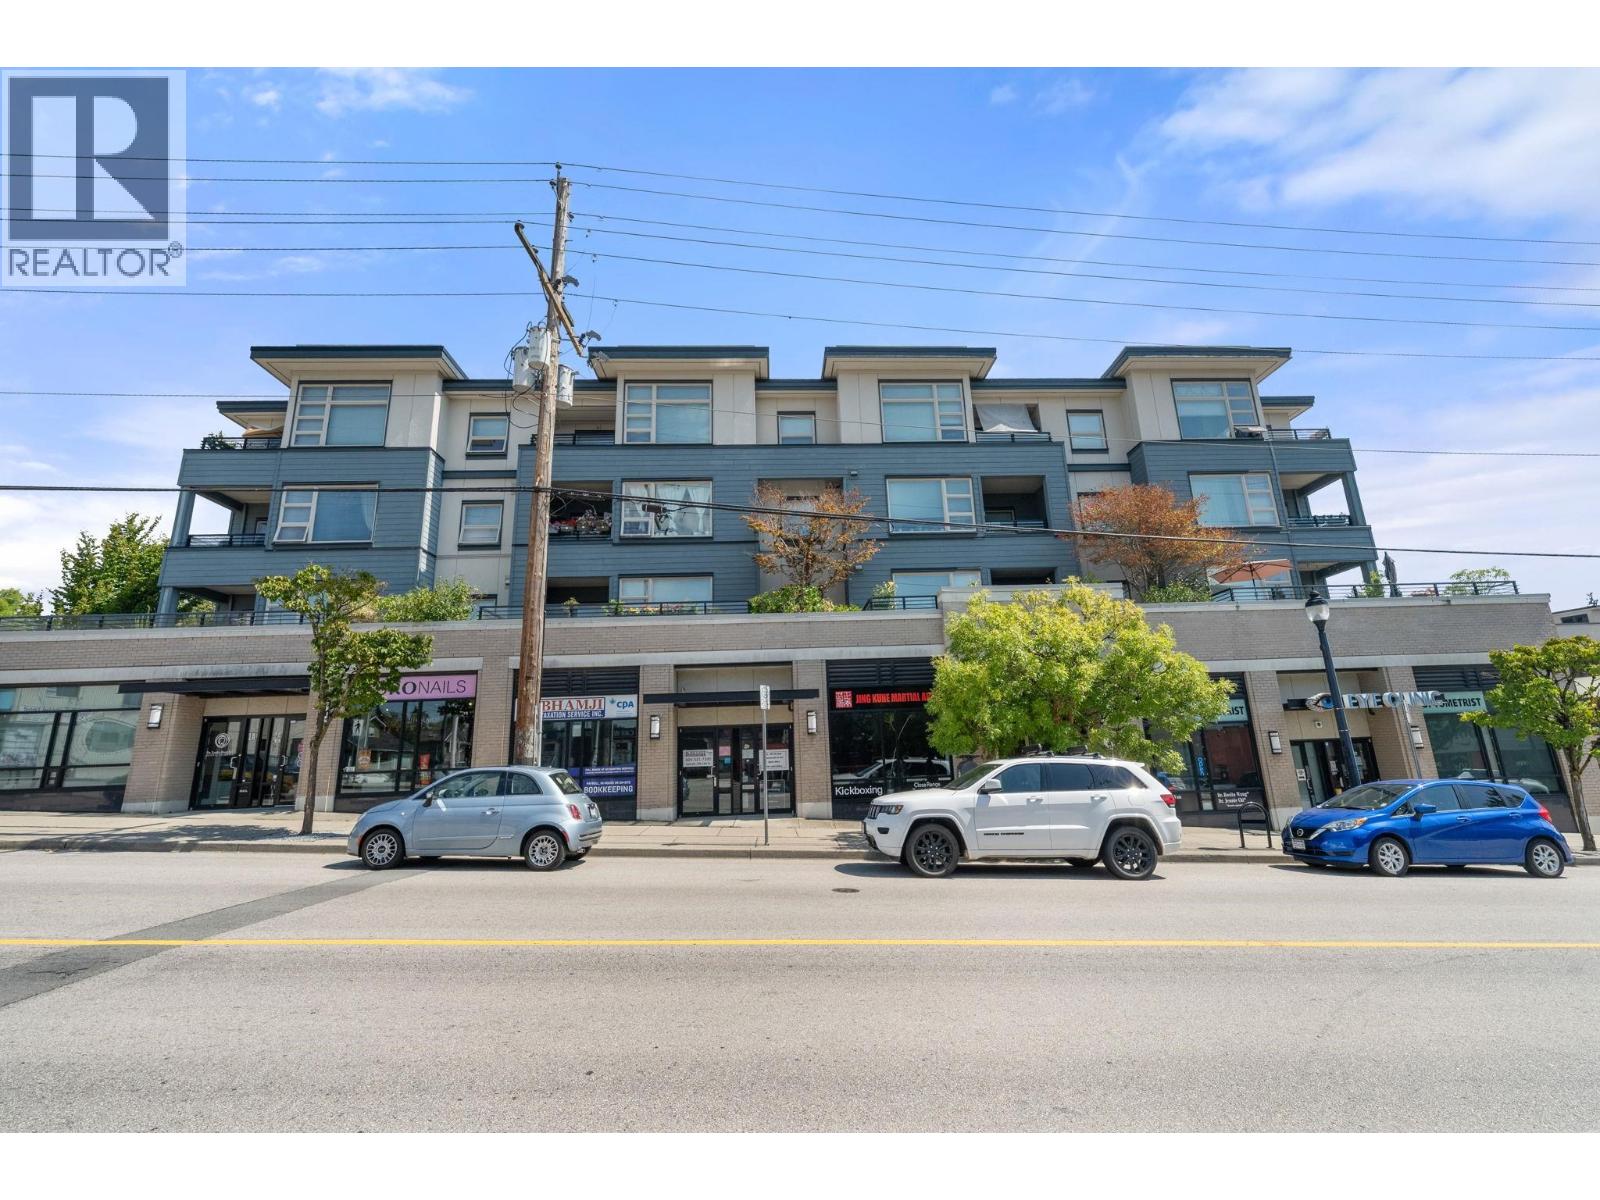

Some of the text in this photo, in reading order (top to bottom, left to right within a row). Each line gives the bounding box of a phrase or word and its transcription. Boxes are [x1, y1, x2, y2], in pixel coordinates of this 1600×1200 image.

[890, 692, 920, 703] MARTIAL
[542, 699, 603, 711] BHAMJI
[584, 785, 633, 793] BOOKKEEPING
[835, 785, 883, 796] Kickboxing
